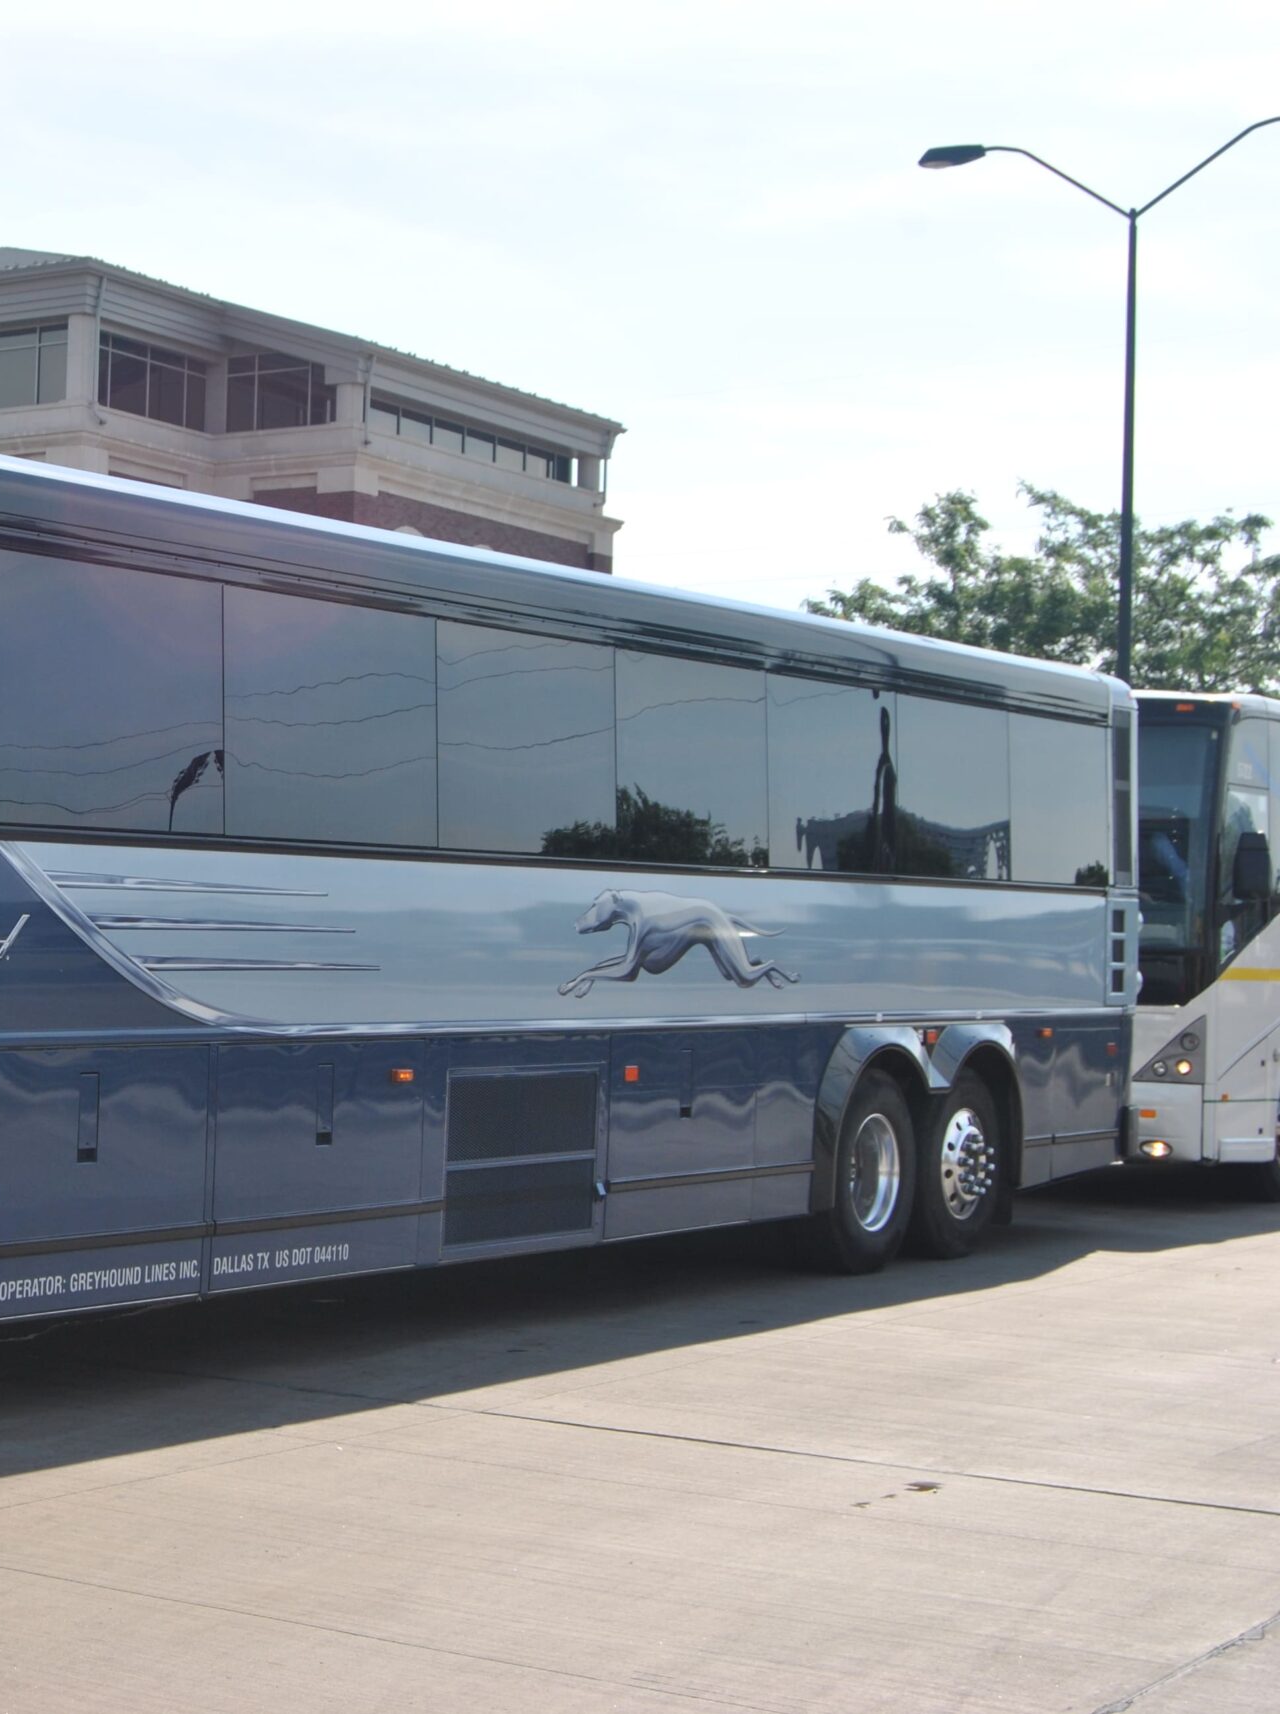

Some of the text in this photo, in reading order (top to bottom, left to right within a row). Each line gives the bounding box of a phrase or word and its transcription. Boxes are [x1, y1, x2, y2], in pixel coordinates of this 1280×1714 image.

[0, 1243, 350, 1301] OPERATOR: GREYHOUND LINES INC. DALLAS TX US DOT 044110
